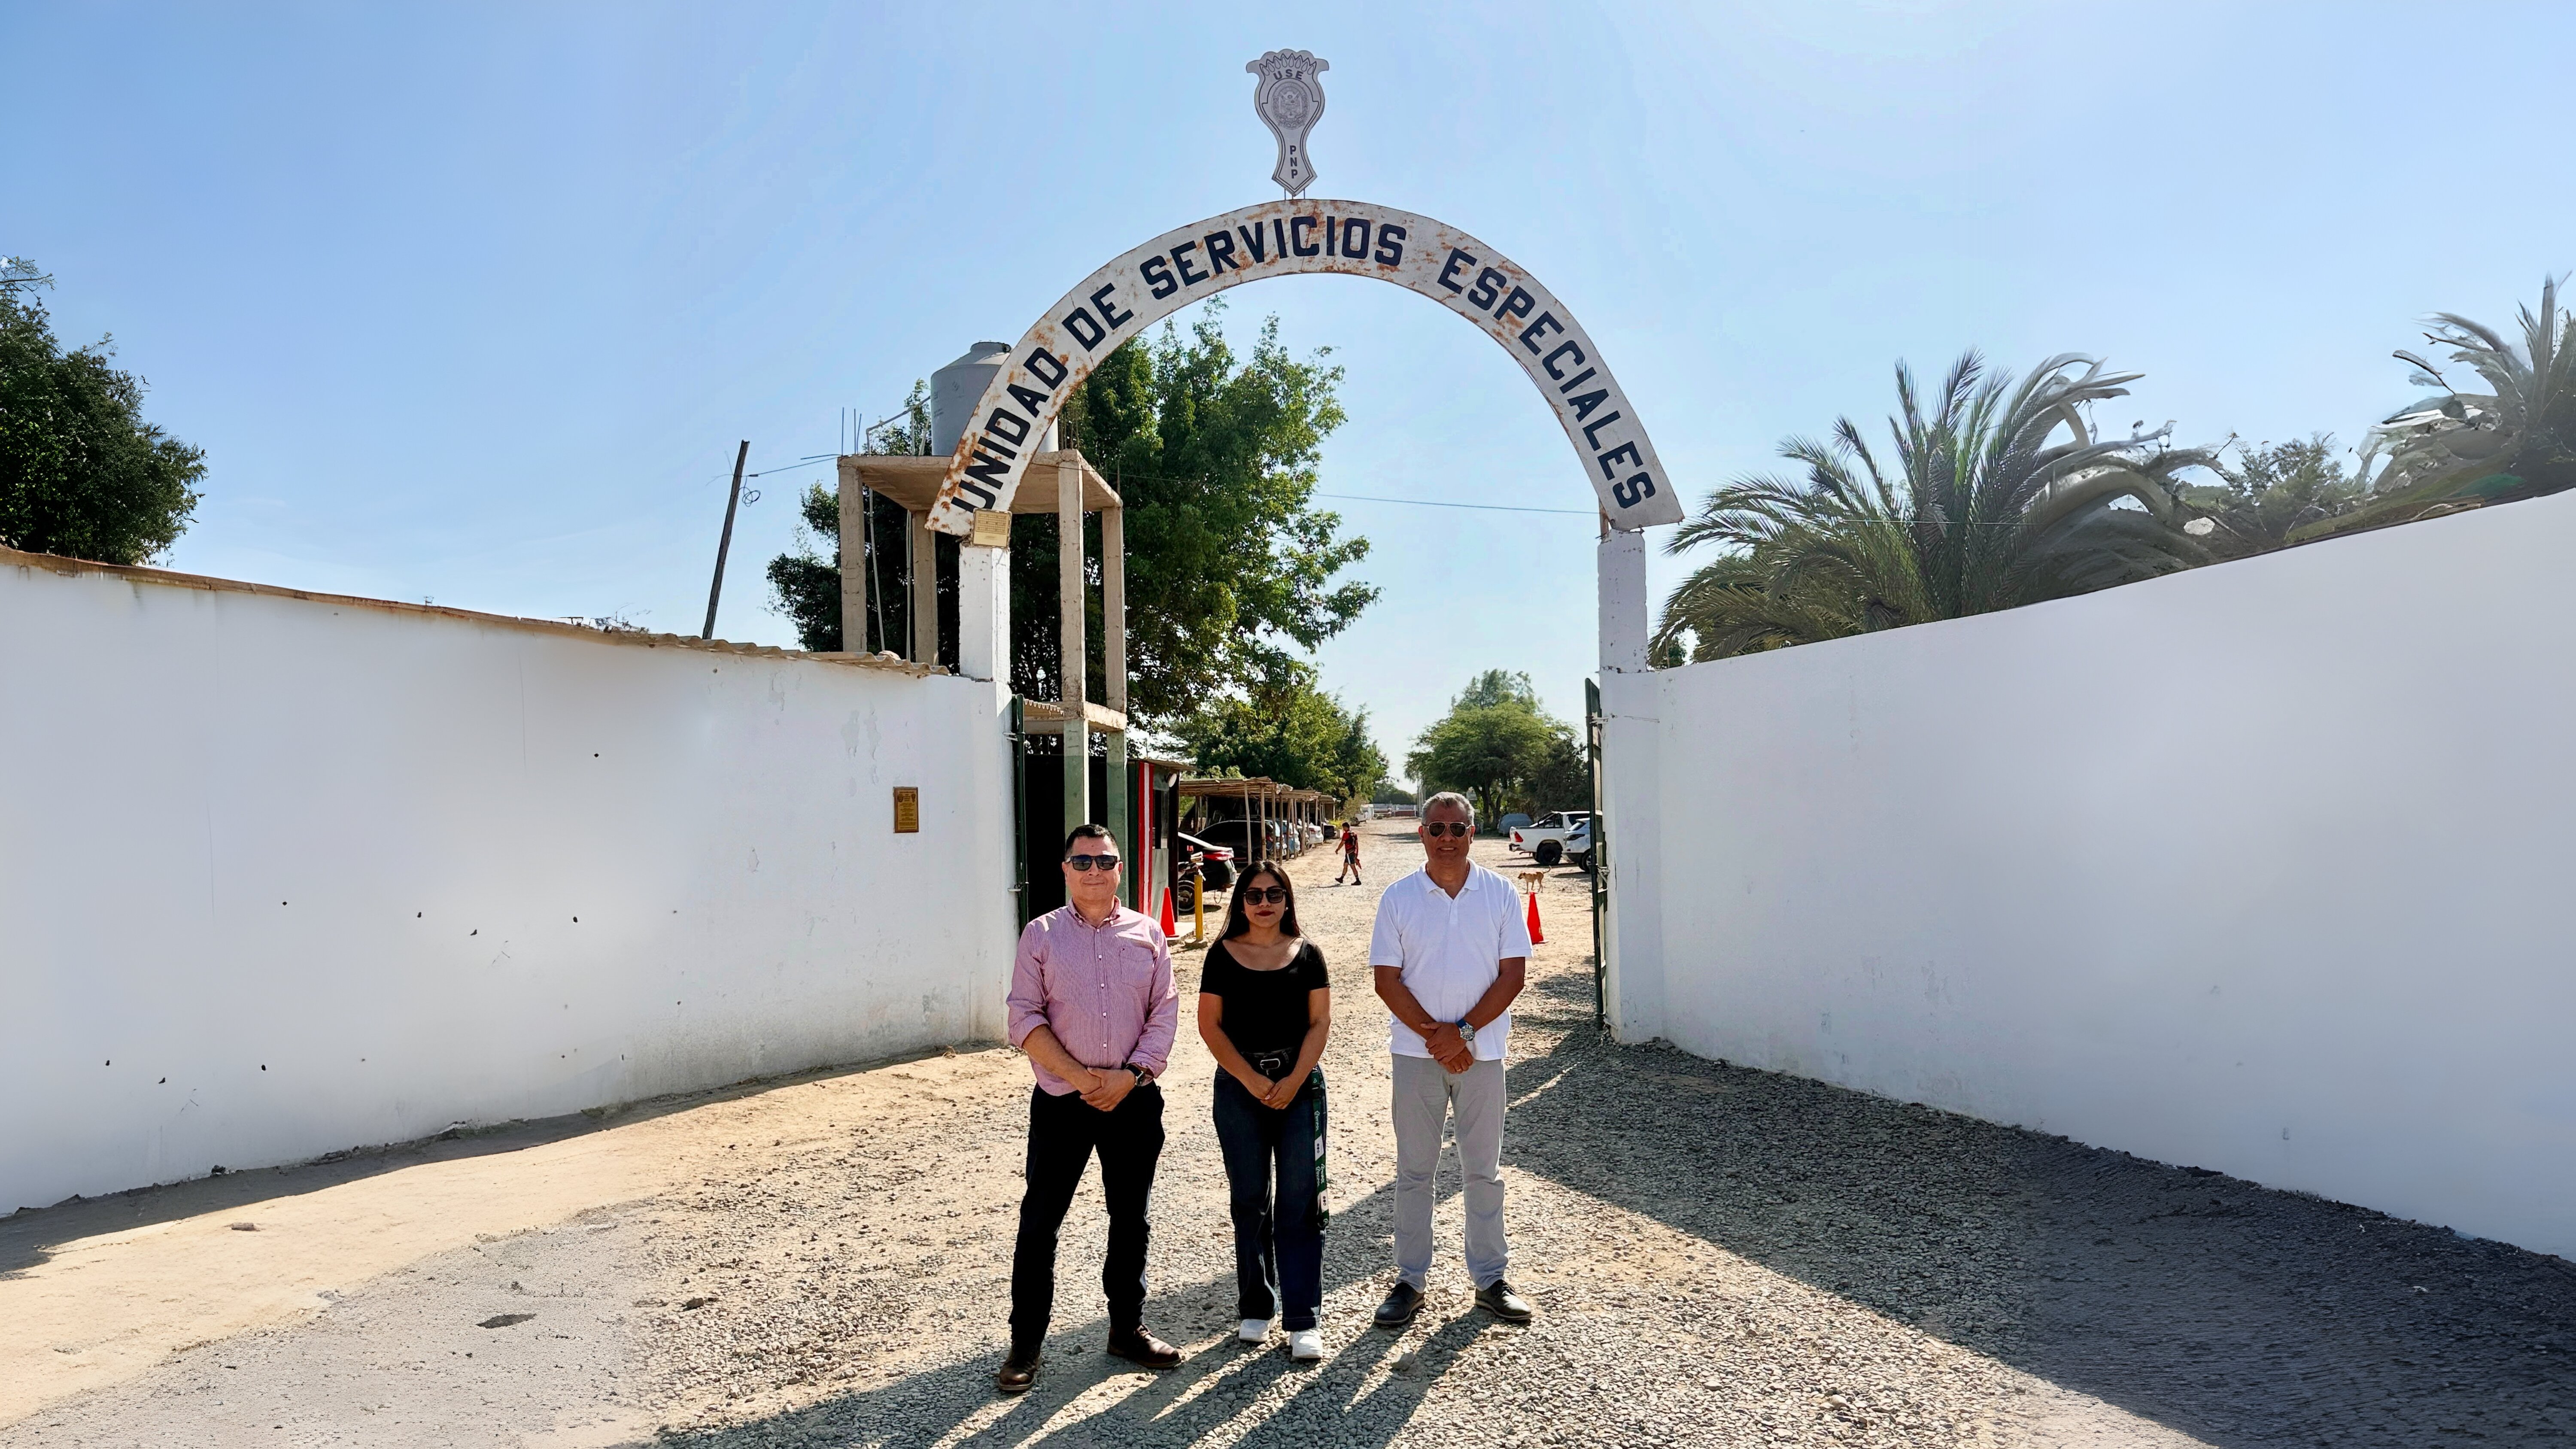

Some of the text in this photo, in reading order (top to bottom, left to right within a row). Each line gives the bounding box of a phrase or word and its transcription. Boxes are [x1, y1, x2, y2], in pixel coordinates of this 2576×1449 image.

[1273, 69, 1304, 80] USE
[1289, 145, 1298, 179] PNP
[951, 216, 1656, 513] UNIDAD DE SERVICIOS ESPECIALES
